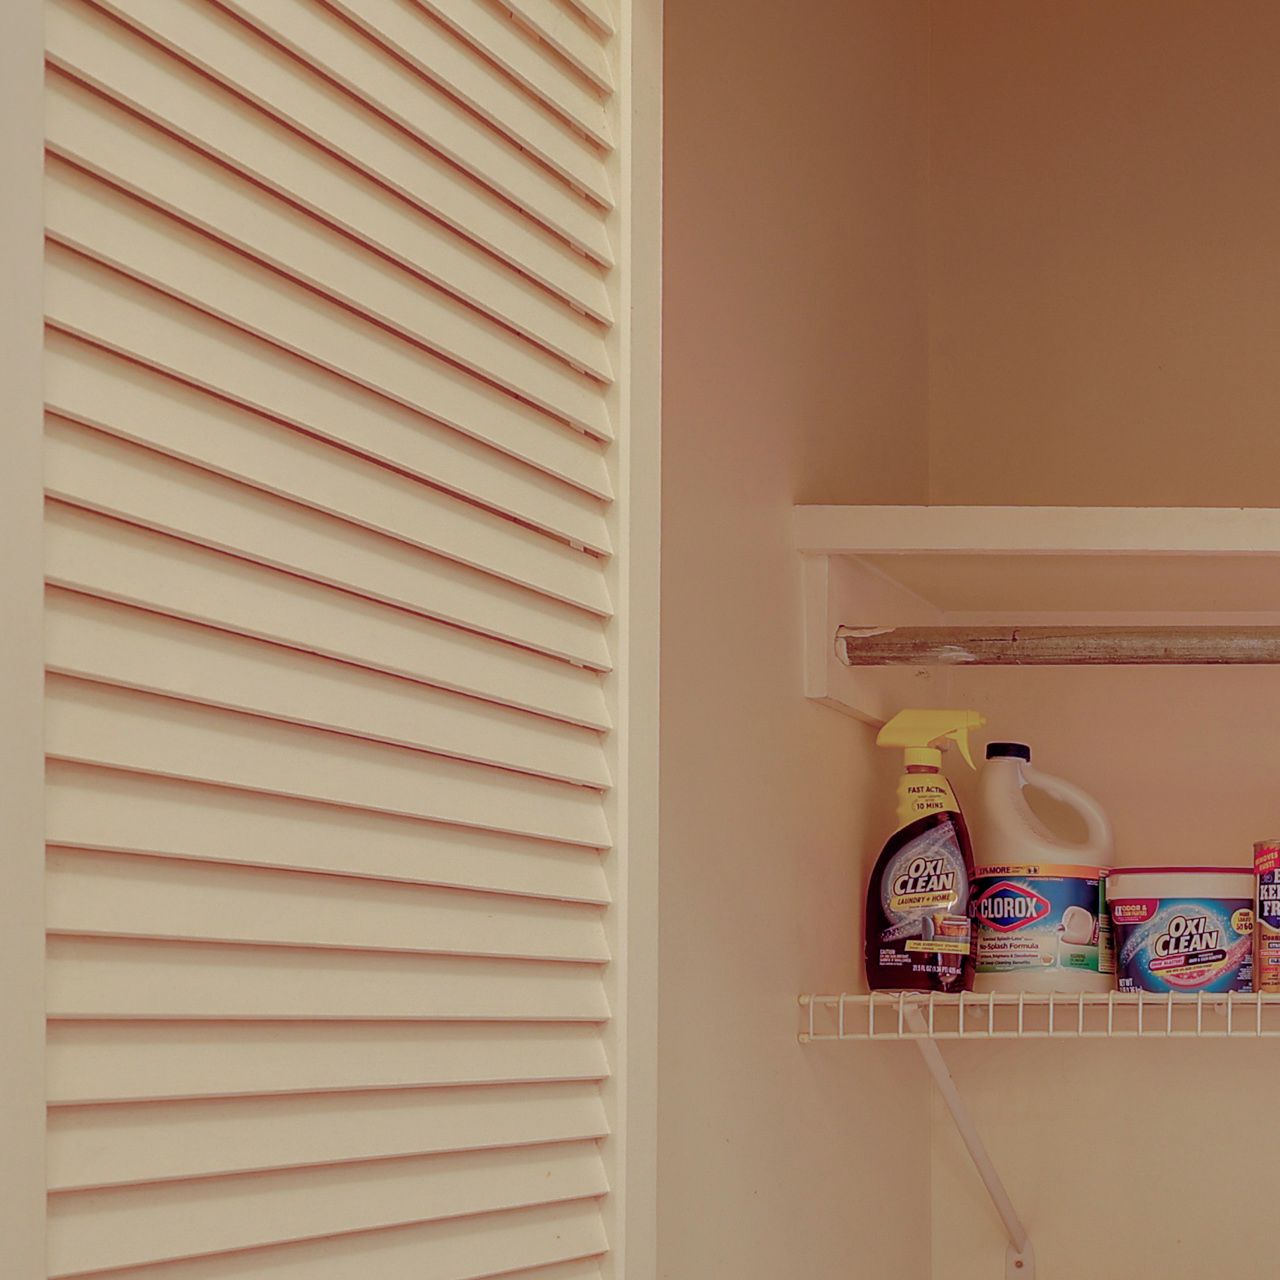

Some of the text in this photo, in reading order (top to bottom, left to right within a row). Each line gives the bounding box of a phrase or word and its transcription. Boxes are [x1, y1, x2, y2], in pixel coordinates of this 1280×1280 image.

[907, 786, 924, 794] FAST
[908, 857, 945, 878] OXI
[991, 866, 1011, 874] MORE
[893, 871, 955, 896] CLEAN
[896, 896, 926, 906] LAUNDRY
[981, 897, 1038, 918] CLOROX
[1168, 915, 1207, 938] OXI
[1009, 942, 1039, 950] Formula
[1155, 930, 1219, 958] CLEAN
